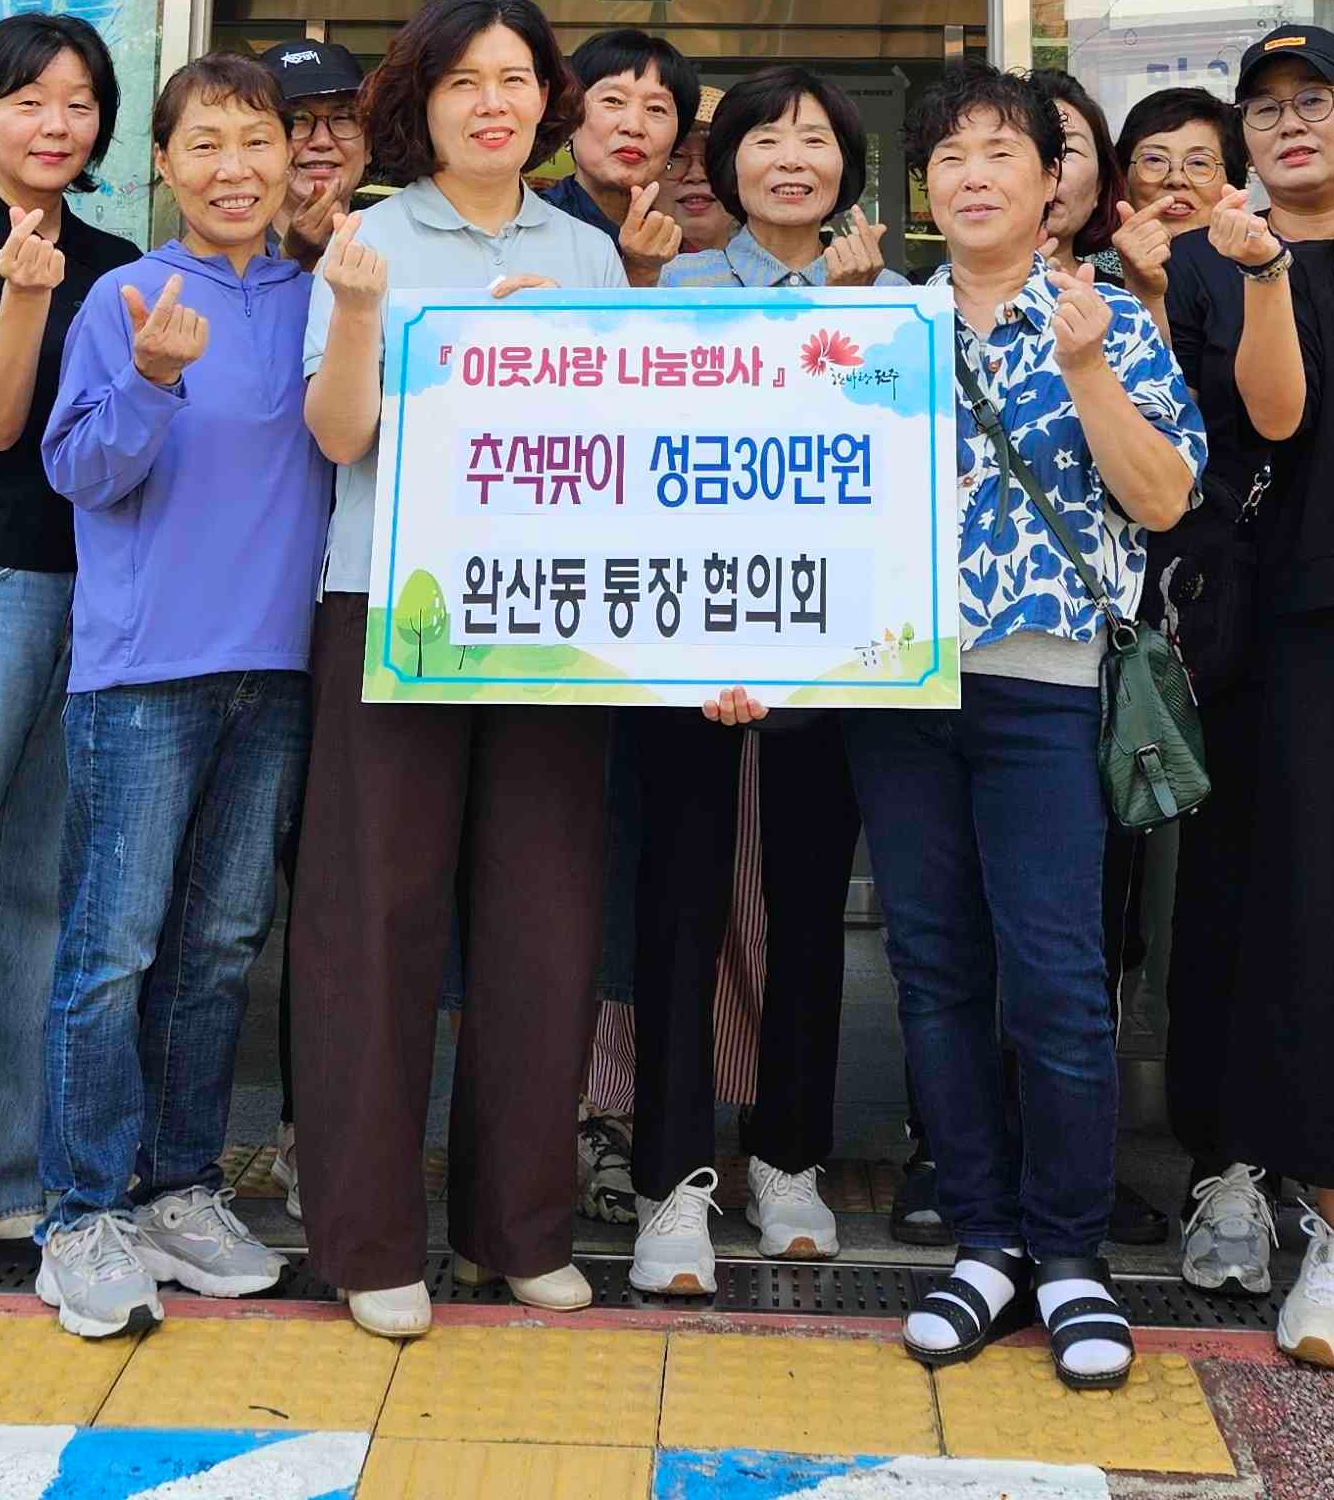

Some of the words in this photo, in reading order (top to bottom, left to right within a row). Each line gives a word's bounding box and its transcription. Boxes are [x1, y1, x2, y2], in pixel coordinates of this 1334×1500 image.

[463, 346, 607, 387] 이웃사랑
[618, 346, 763, 387] 나눔행사
[467, 433, 624, 505] 추석맞이
[649, 433, 872, 507] 성금30만원
[462, 555, 586, 639] 완산동
[603, 558, 687, 638] 통장
[704, 552, 827, 634] 협의회
